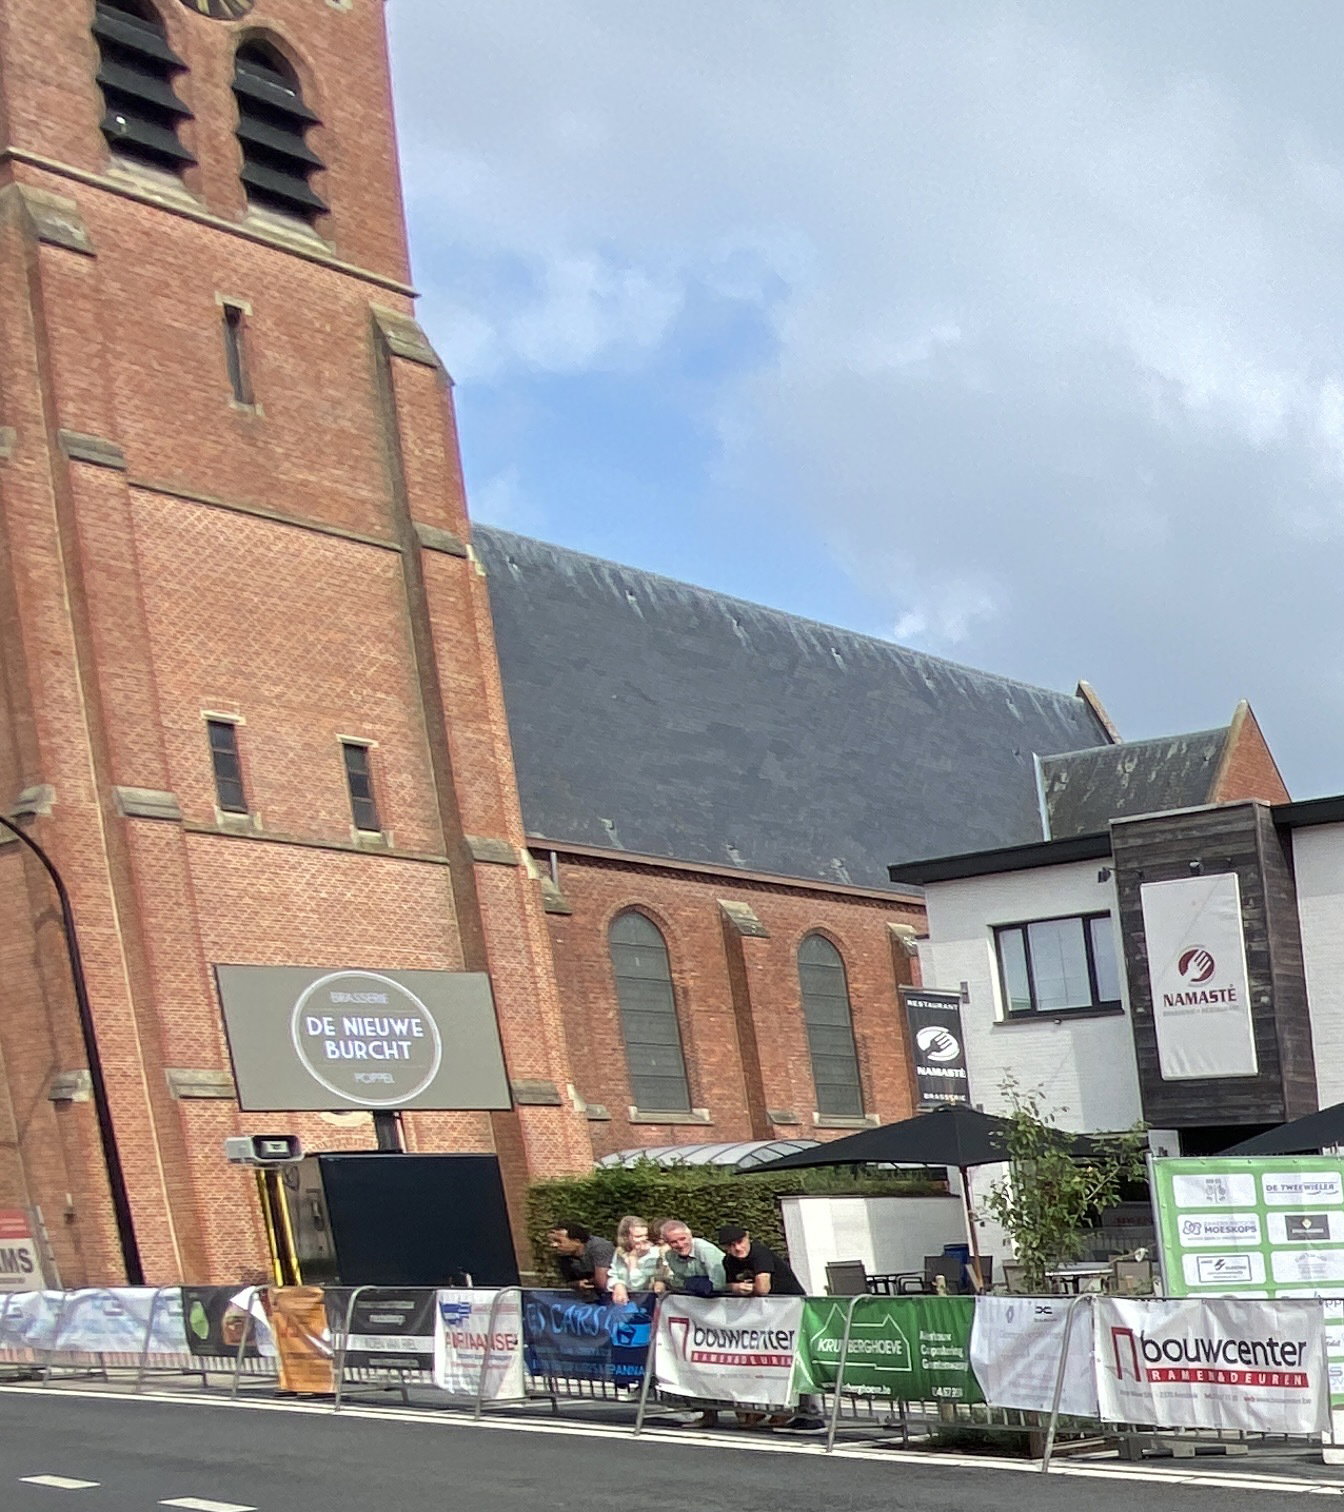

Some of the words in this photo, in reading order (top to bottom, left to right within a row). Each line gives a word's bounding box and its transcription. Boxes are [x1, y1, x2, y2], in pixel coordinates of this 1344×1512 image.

[306, 1016, 336, 1036] DE
[343, 1017, 424, 1037] NIEUWE
[325, 1040, 412, 1060] BURCHT
[1266, 1184, 1278, 1192] DE
[1204, 1225, 1257, 1233] MOESKOPS
[1141, 1330, 1307, 1368] bouwcenter
